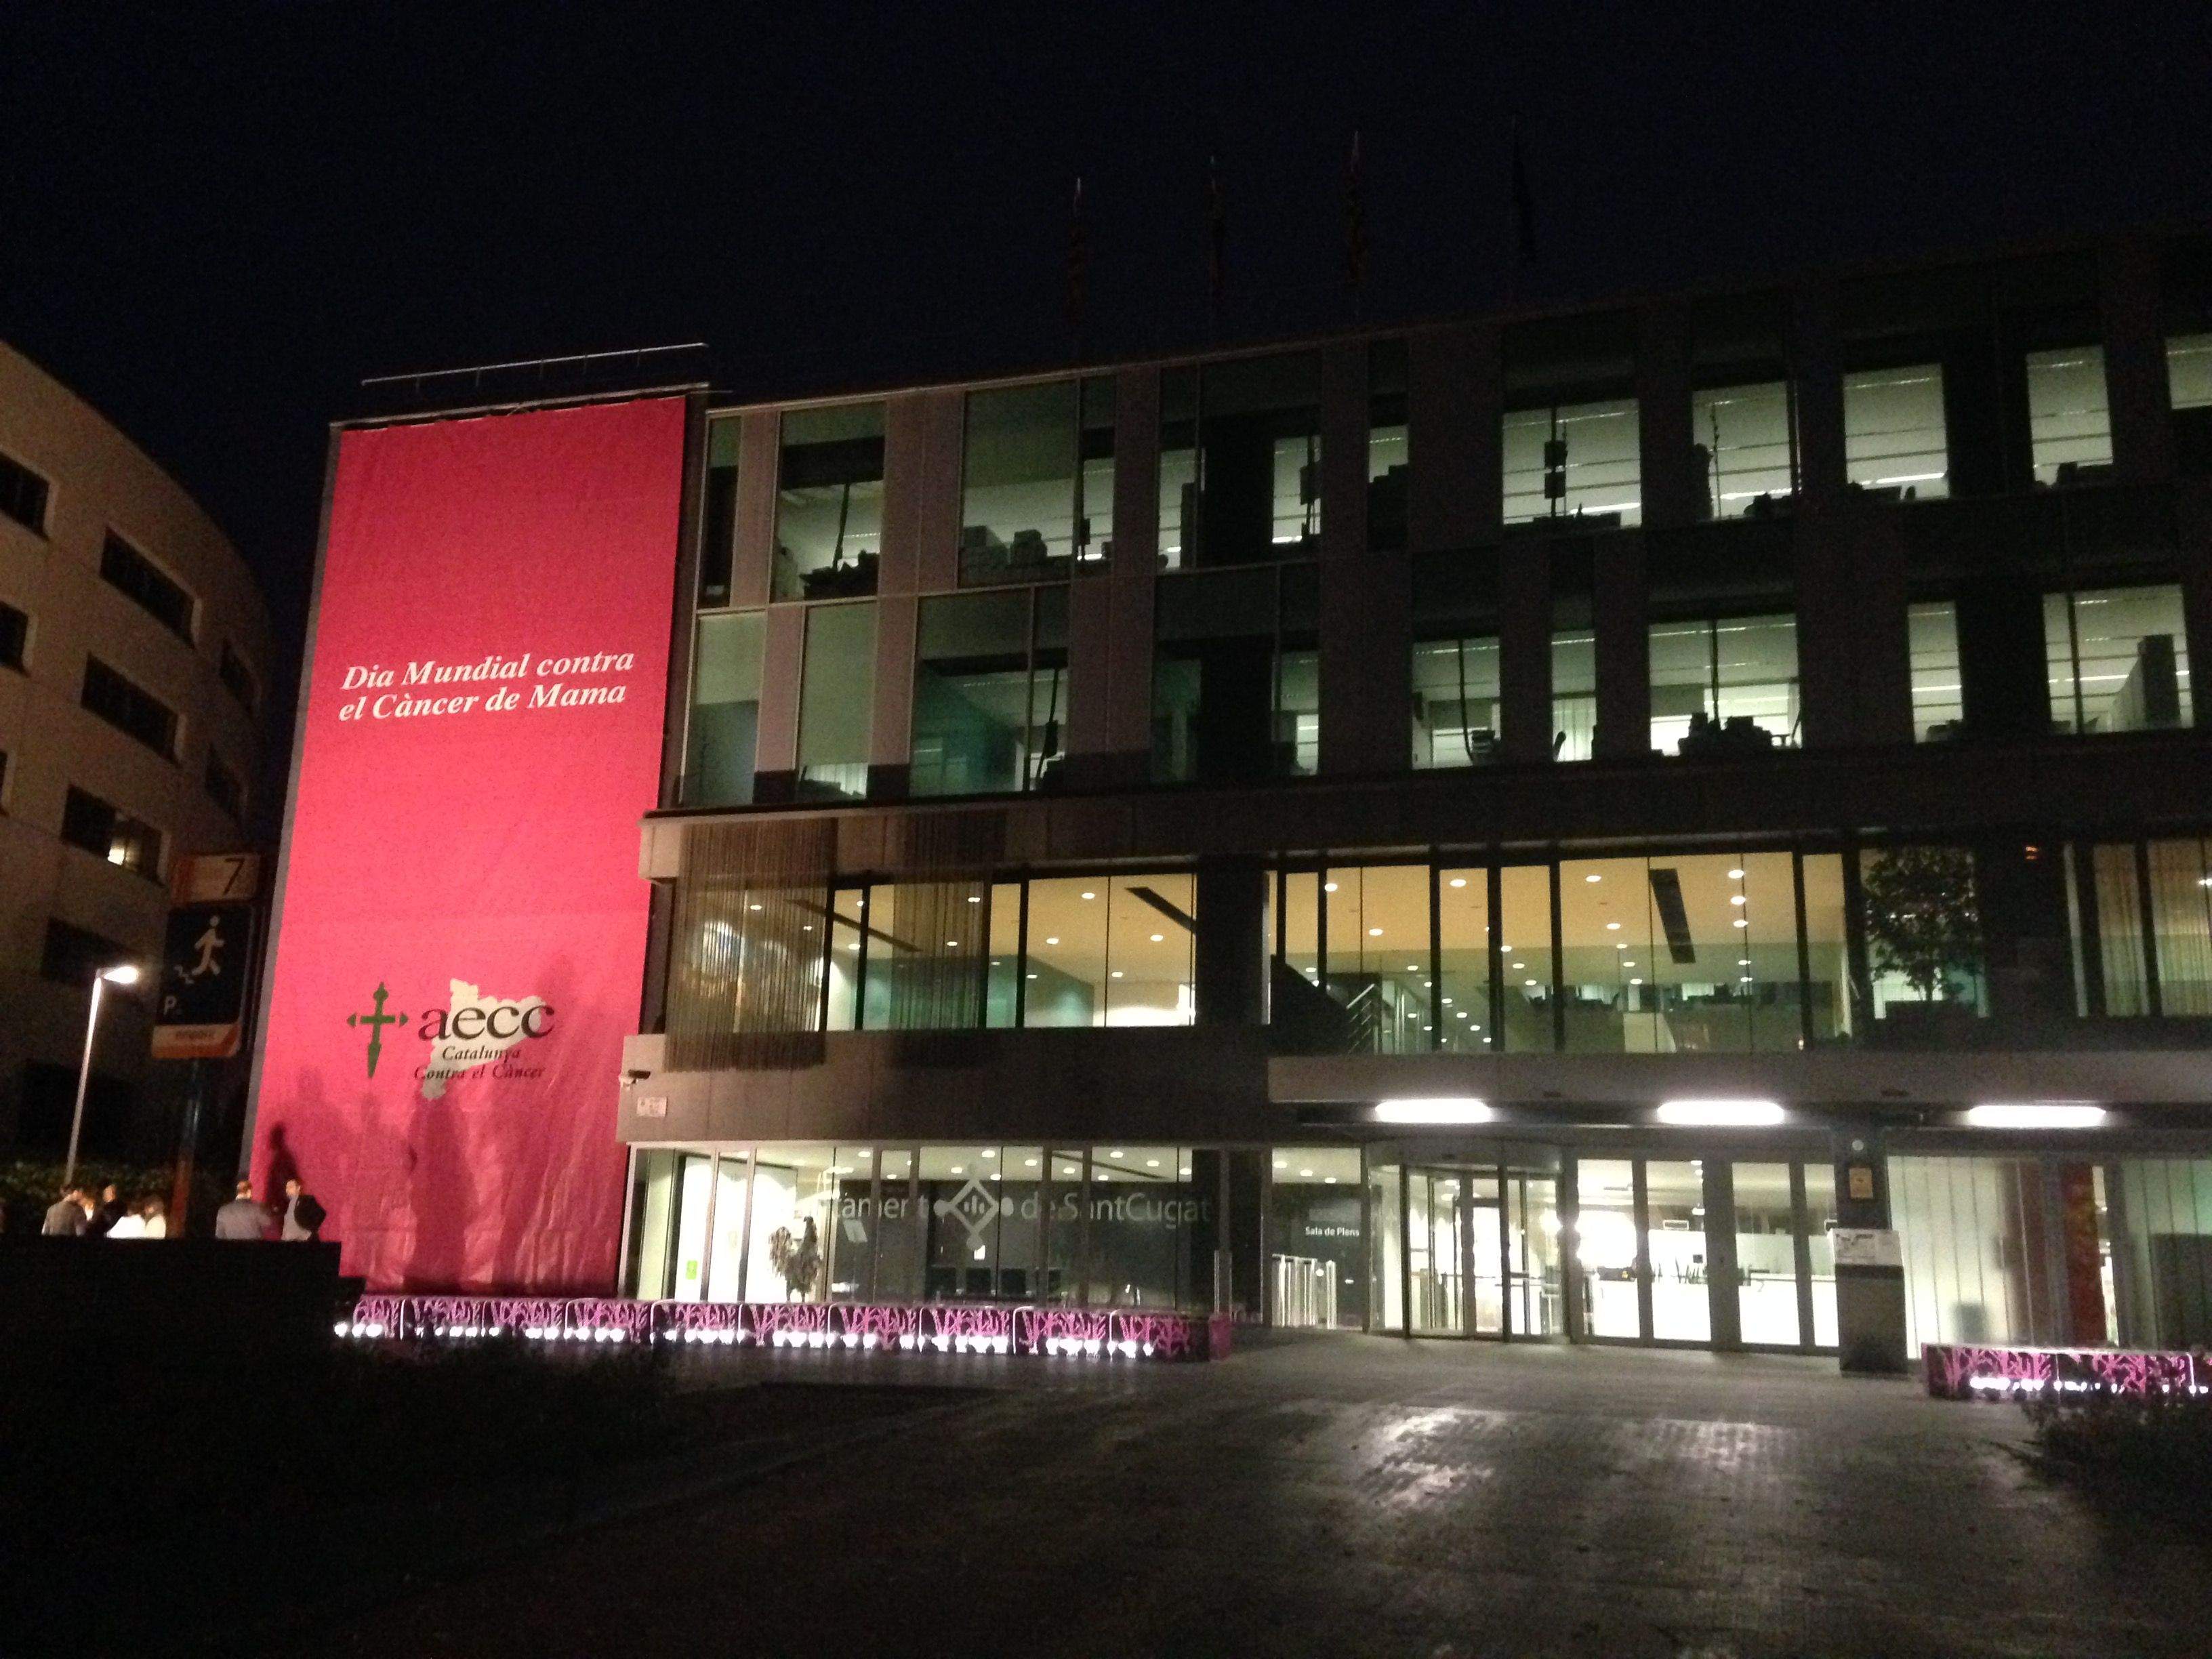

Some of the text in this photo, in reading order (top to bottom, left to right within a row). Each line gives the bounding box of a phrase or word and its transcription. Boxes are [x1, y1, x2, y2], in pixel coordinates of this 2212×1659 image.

[340, 651, 635, 690] Dia Mundial contra
[338, 682, 627, 722] el Càncer de Mama
[418, 1004, 555, 1040] aecc
[442, 1045, 522, 1063] Catalunya
[413, 1066, 467, 1080] Contra
[472, 1064, 486, 1080] el
[1305, 1226, 1323, 1235] Sala
[1324, 1227, 1335, 1236] de
